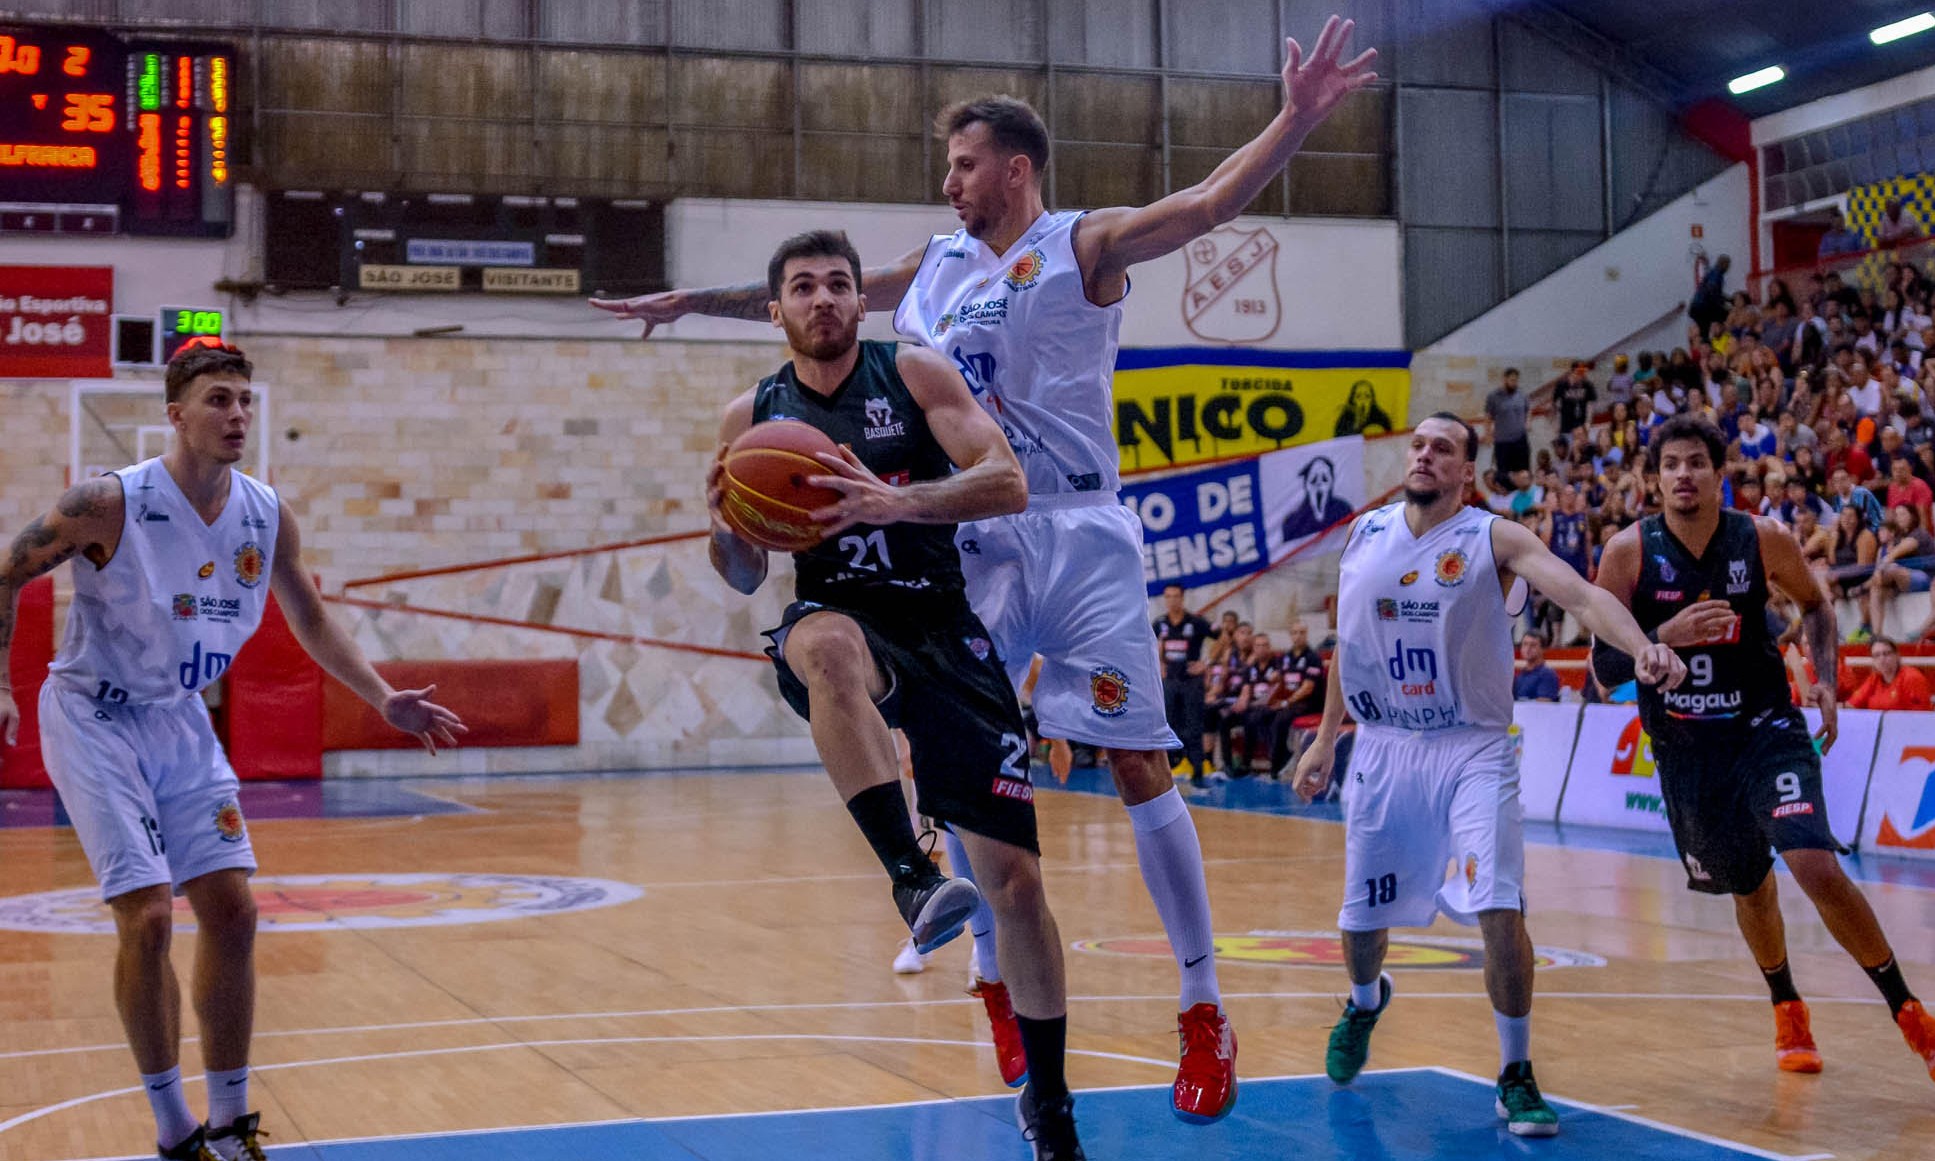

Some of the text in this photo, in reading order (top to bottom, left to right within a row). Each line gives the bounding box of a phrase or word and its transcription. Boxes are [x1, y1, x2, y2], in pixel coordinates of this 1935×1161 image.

[63, 45, 90, 77] 2
[62, 93, 115, 132] 35
[486, 274, 574, 288] VISITANTE
[20, 295, 107, 316] Esportiva
[981, 296, 1008, 310] JOSÉ
[6, 315, 85, 345] José
[1221, 377, 1293, 392] TORCIDA
[864, 421, 906, 440] BASQUETE
[1197, 474, 1254, 523] DE
[838, 529, 893, 573] 21
[1389, 638, 1437, 681] dm
[1690, 653, 1713, 687] 9
[1401, 680, 1436, 696] card
[1348, 690, 1382, 721] 18
[1000, 732, 1032, 783] 2
[1775, 772, 1801, 803] 9
[1365, 872, 1397, 908] 18
